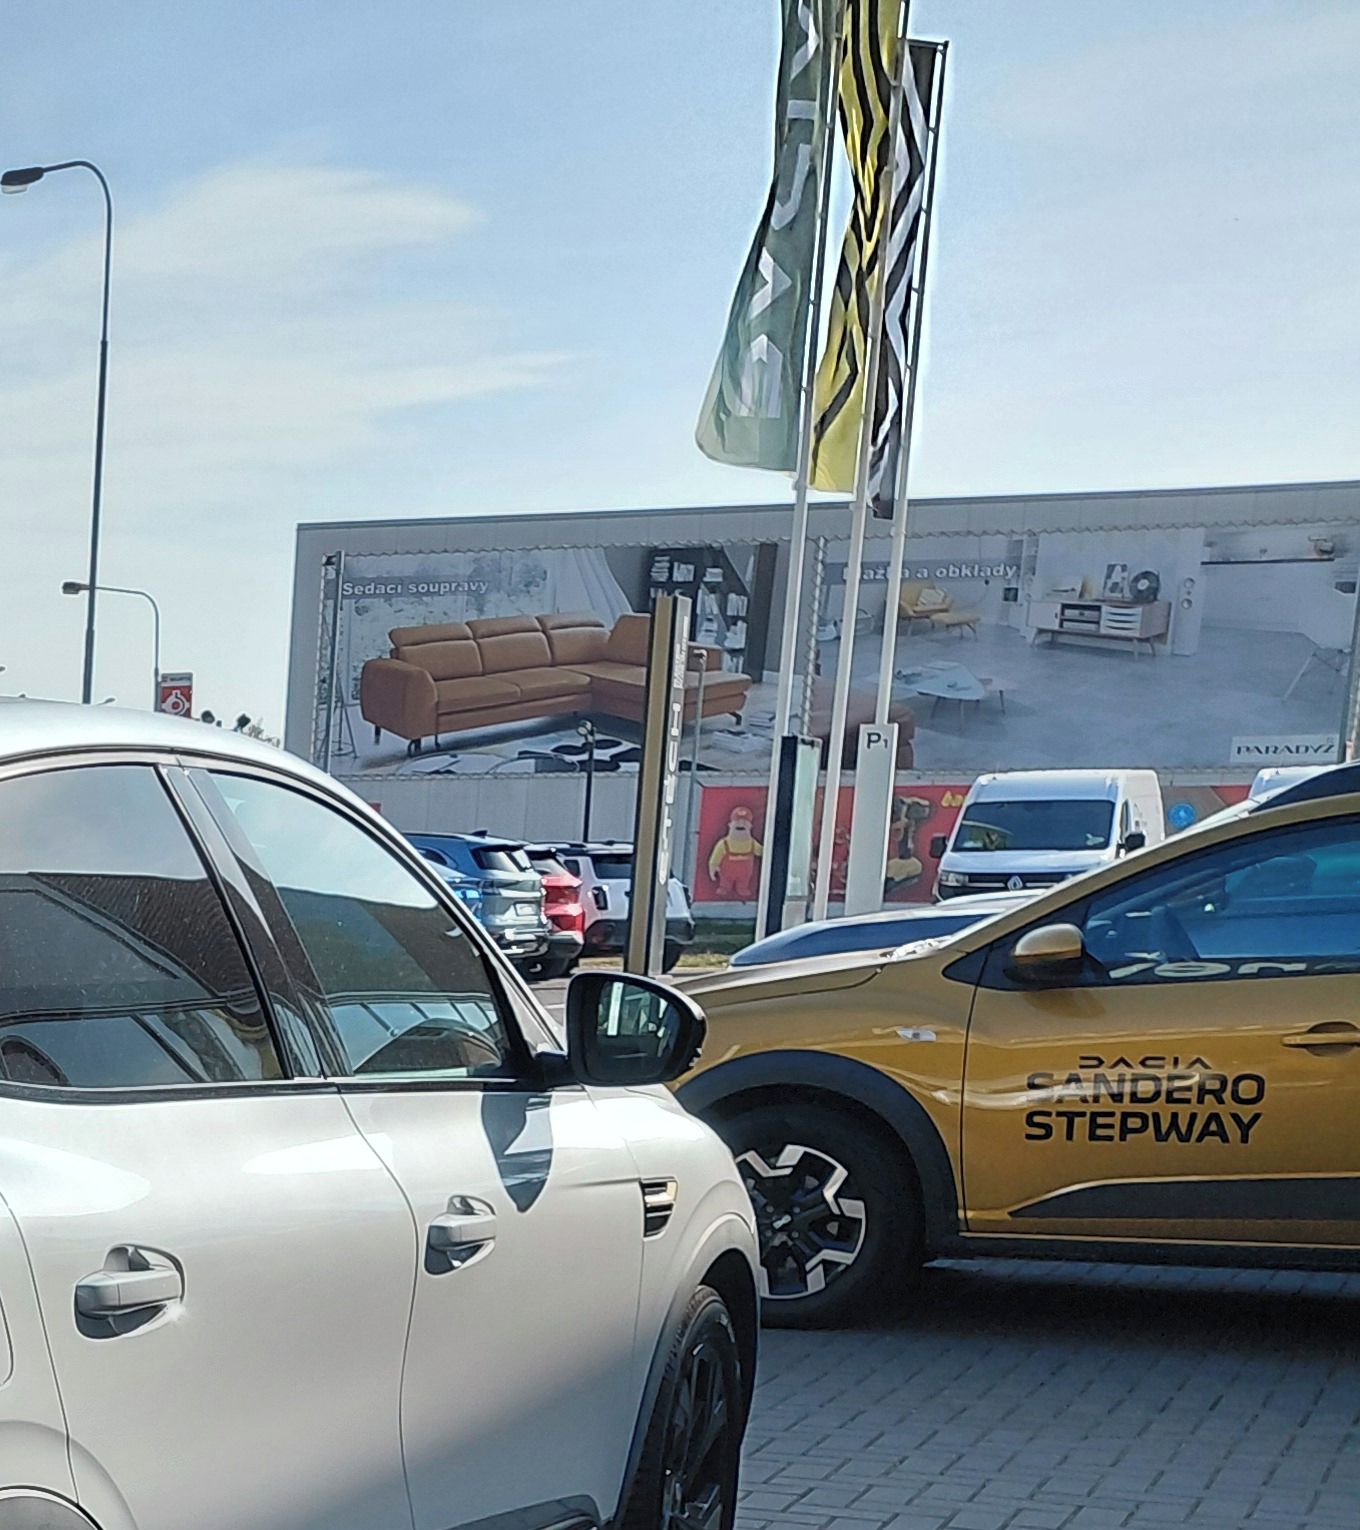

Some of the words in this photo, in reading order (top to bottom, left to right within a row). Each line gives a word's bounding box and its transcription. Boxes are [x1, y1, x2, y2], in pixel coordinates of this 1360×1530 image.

[935, 563, 1017, 579] obklady
[408, 580, 489, 595] soupravy
[1078, 1056, 1213, 1070] DACIA
[1026, 1072, 1266, 1105] SANDERO
[1025, 1111, 1263, 1144] STEPWAY
